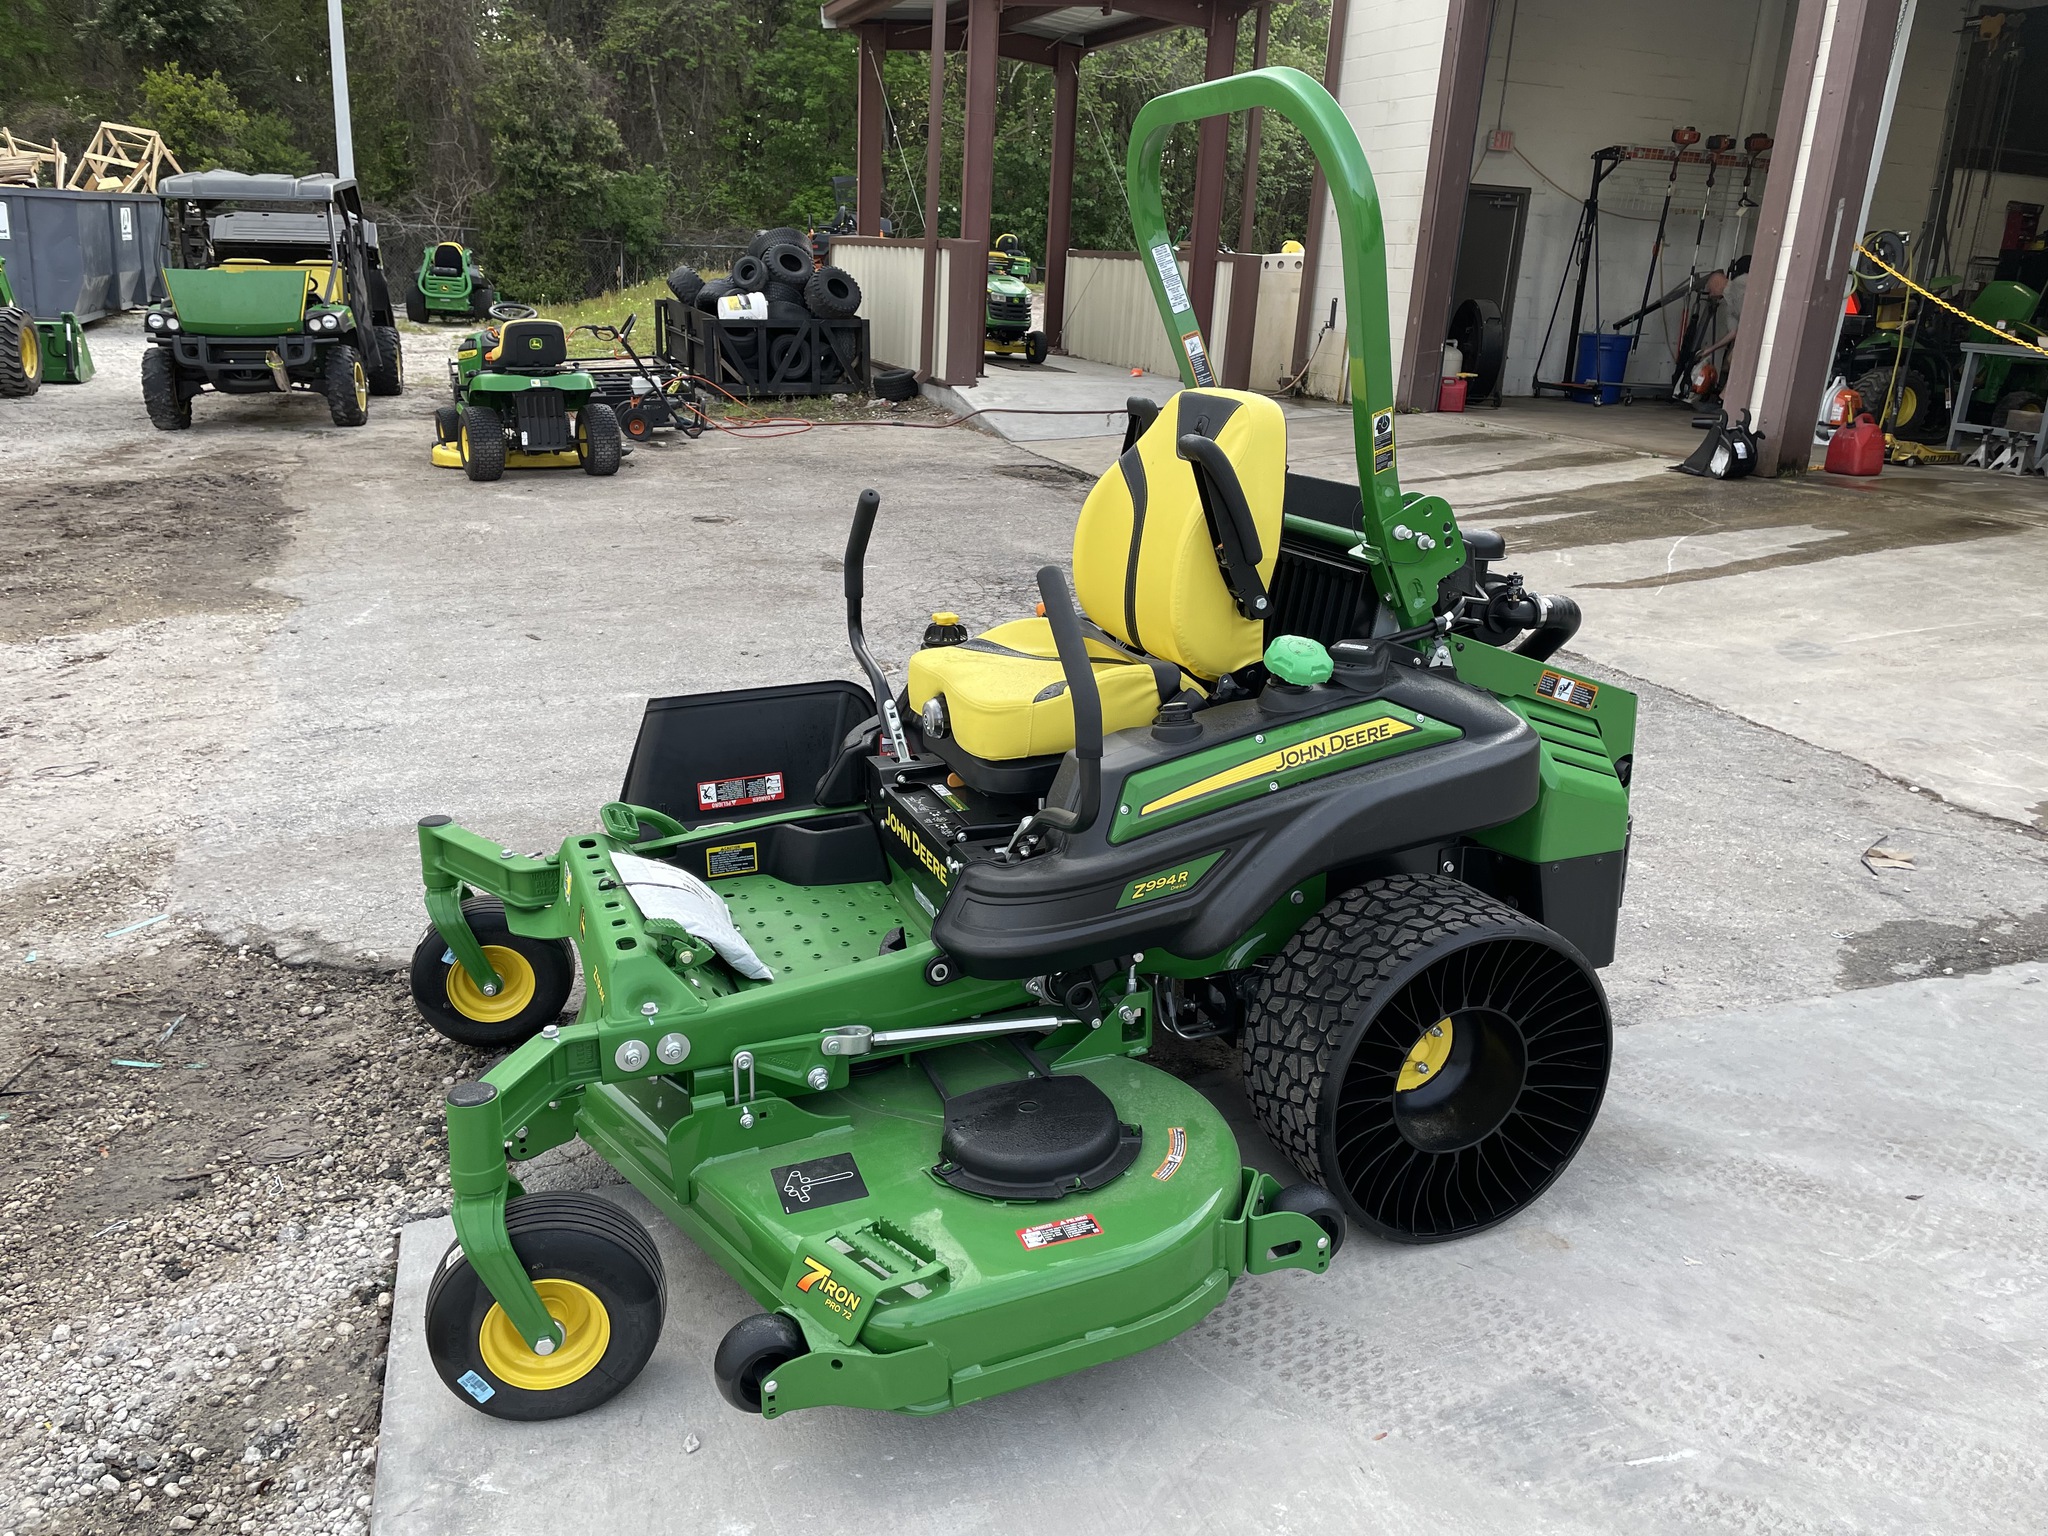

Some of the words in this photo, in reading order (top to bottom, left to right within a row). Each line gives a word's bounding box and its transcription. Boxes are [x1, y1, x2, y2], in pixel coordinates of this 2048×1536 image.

[1276, 742, 1326, 769] JOHN
[1330, 723, 1390, 752] DEERE
[885, 806, 911, 848] JOHN
[912, 830, 948, 887] DEERE
[1170, 882, 1188, 891] Diesel
[824, 1299, 841, 1313] PRO
[841, 1308, 853, 1321] 72
